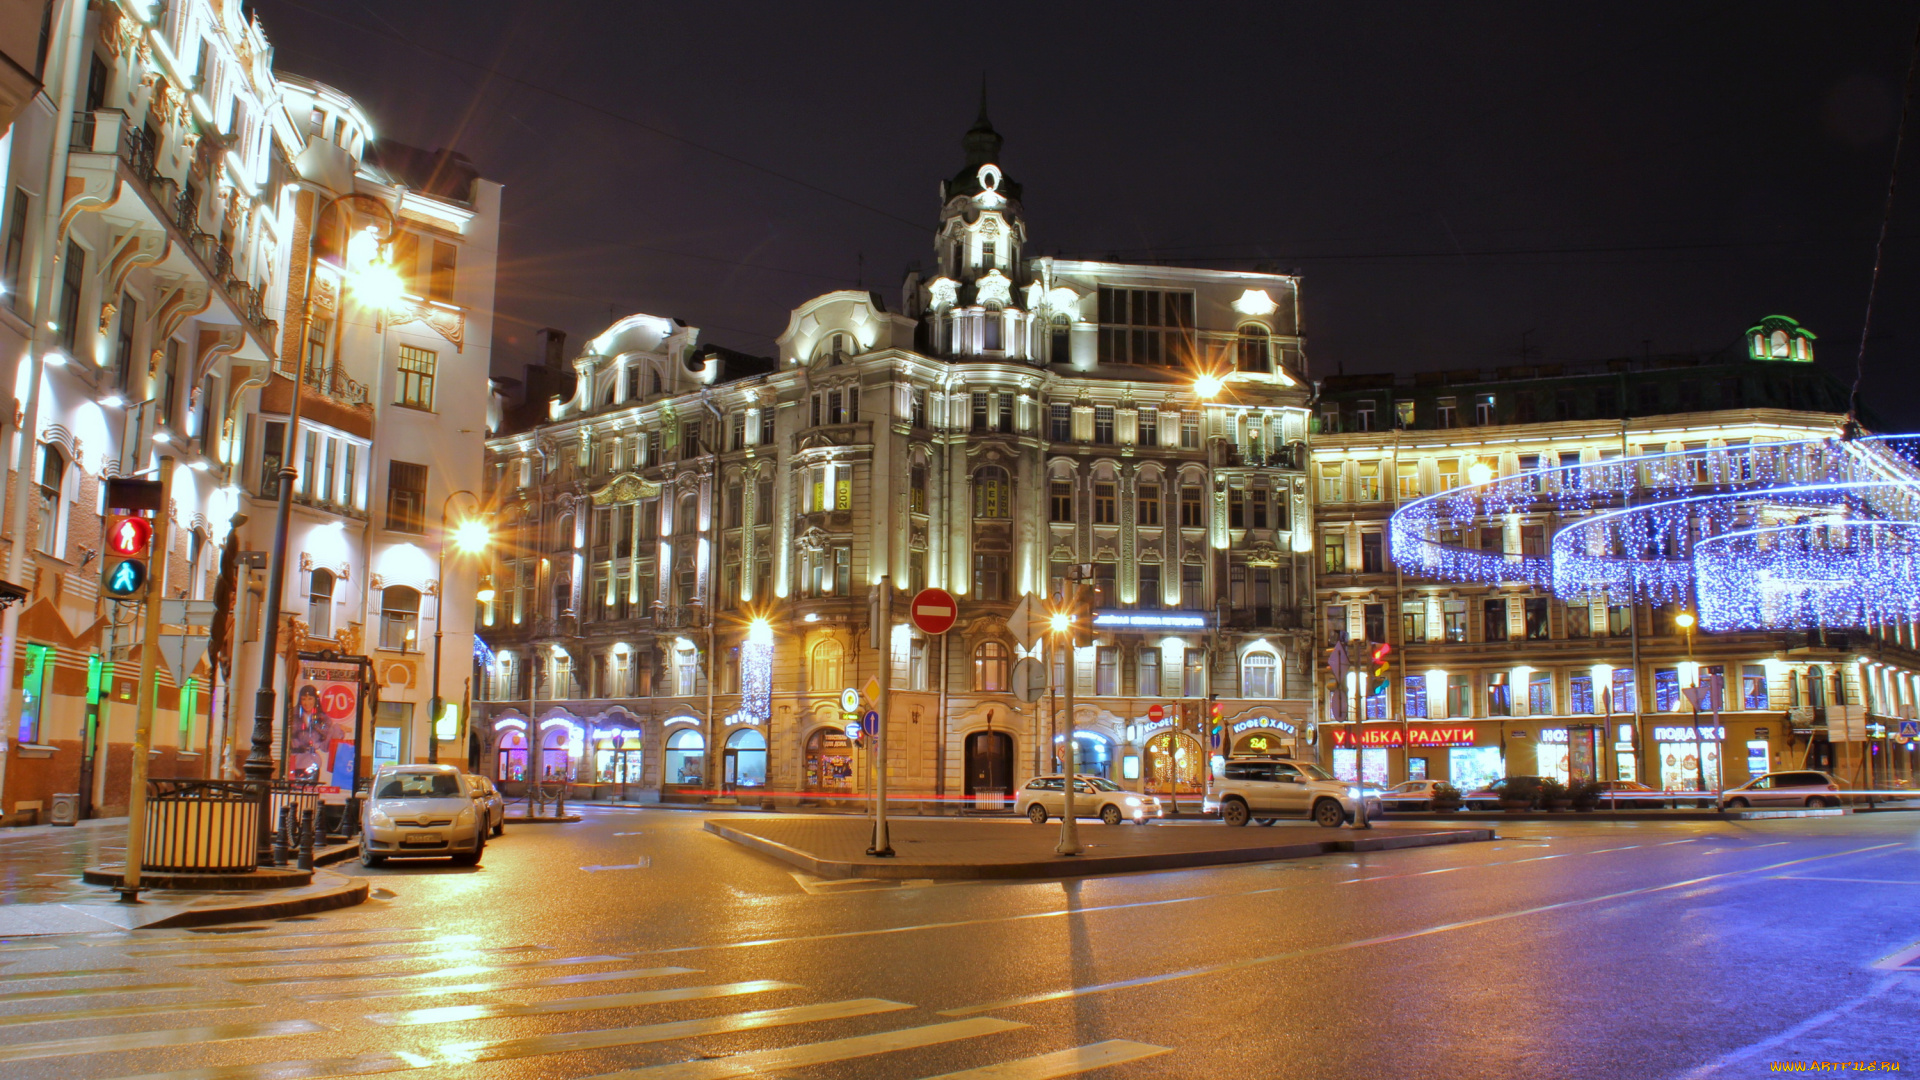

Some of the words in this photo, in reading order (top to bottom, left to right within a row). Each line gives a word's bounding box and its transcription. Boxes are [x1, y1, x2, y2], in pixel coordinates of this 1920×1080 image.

[839, 488, 848, 509] 200
[988, 481, 996, 516] RENT
[1233, 718, 1259, 734] КОФЕ
[1269, 719, 1295, 734] ХАУЗ
[1250, 737, 1267, 750] 24
[1409, 729, 1475, 743] РАДУГИ
